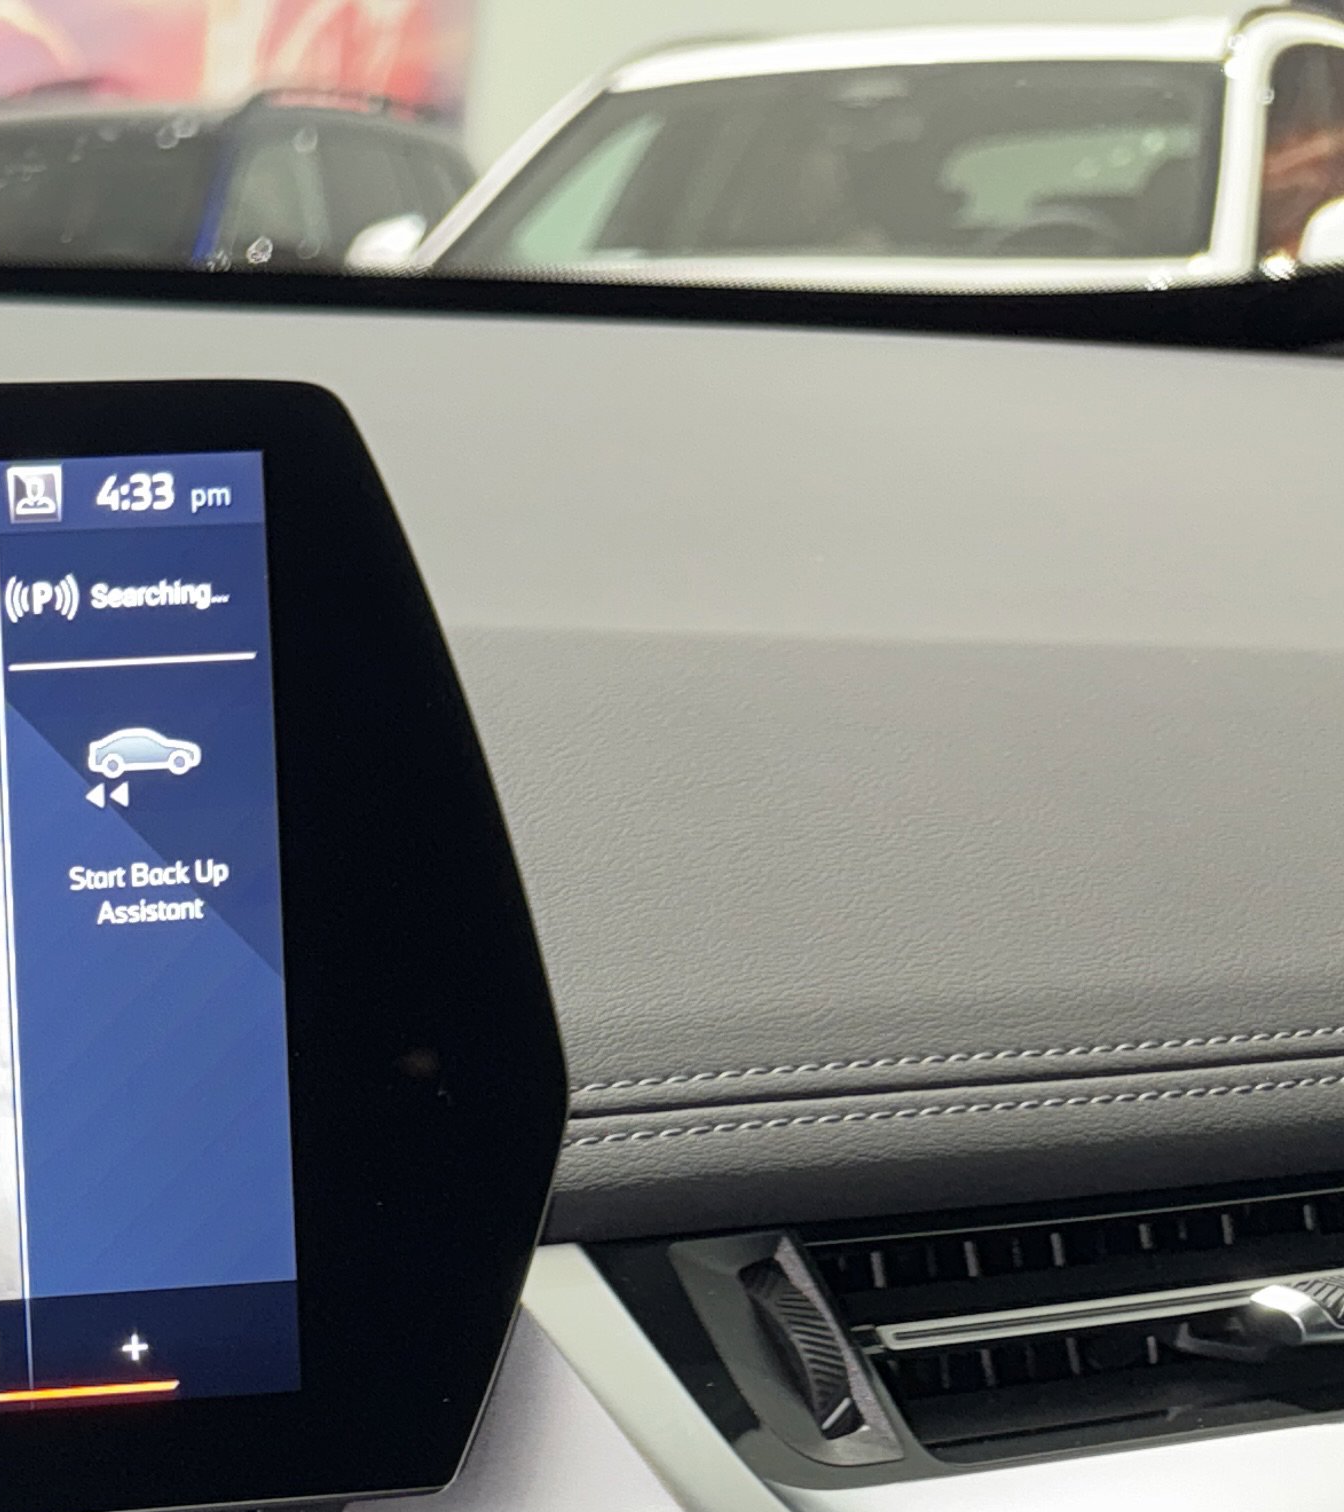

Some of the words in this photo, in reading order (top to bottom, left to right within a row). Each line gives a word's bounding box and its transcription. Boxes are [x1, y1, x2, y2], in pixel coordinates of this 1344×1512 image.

[95, 472, 177, 512] 4:33
[189, 484, 233, 514] pm
[69, 865, 126, 892] Start
[130, 860, 191, 888] Back
[194, 857, 230, 888] Up
[96, 898, 206, 925] Assistant
